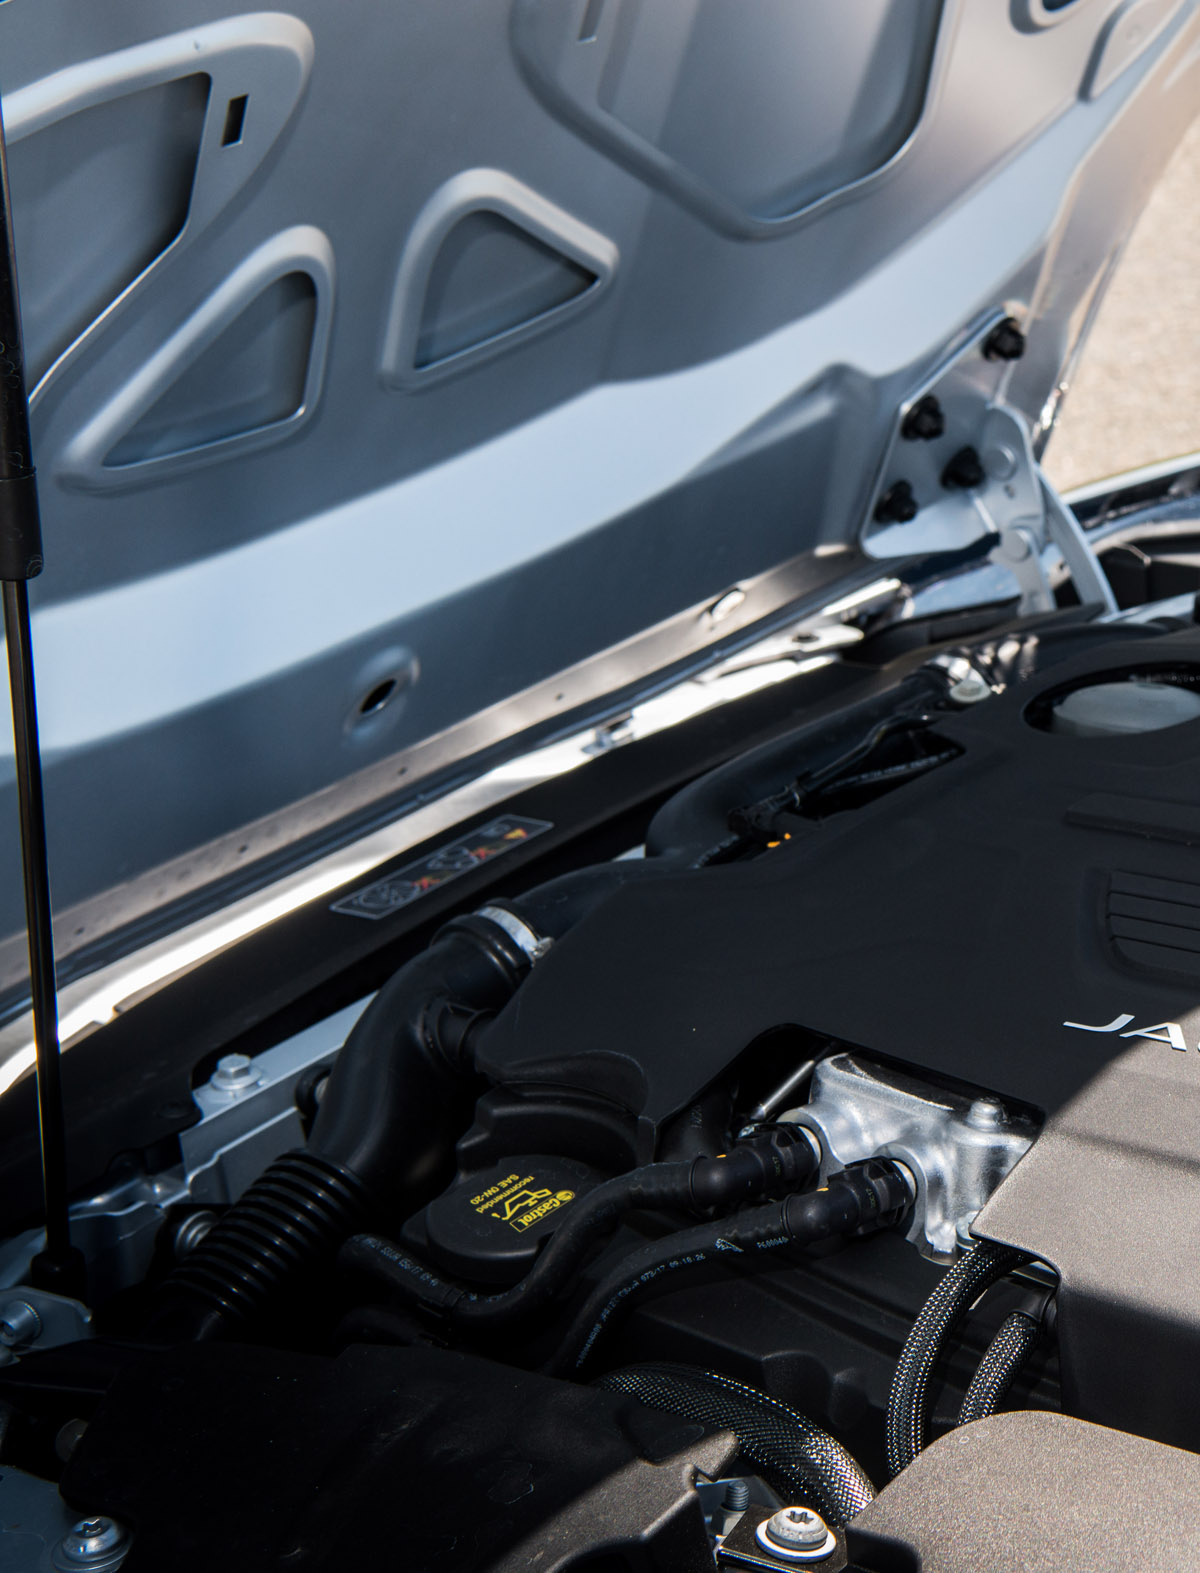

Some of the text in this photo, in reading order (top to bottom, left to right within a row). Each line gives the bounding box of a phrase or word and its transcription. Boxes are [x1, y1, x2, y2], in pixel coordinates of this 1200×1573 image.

[470, 1173, 520, 1205] SAE 0W-20
[475, 1175, 536, 1214] recommended
[517, 1198, 561, 1227] Castrol
